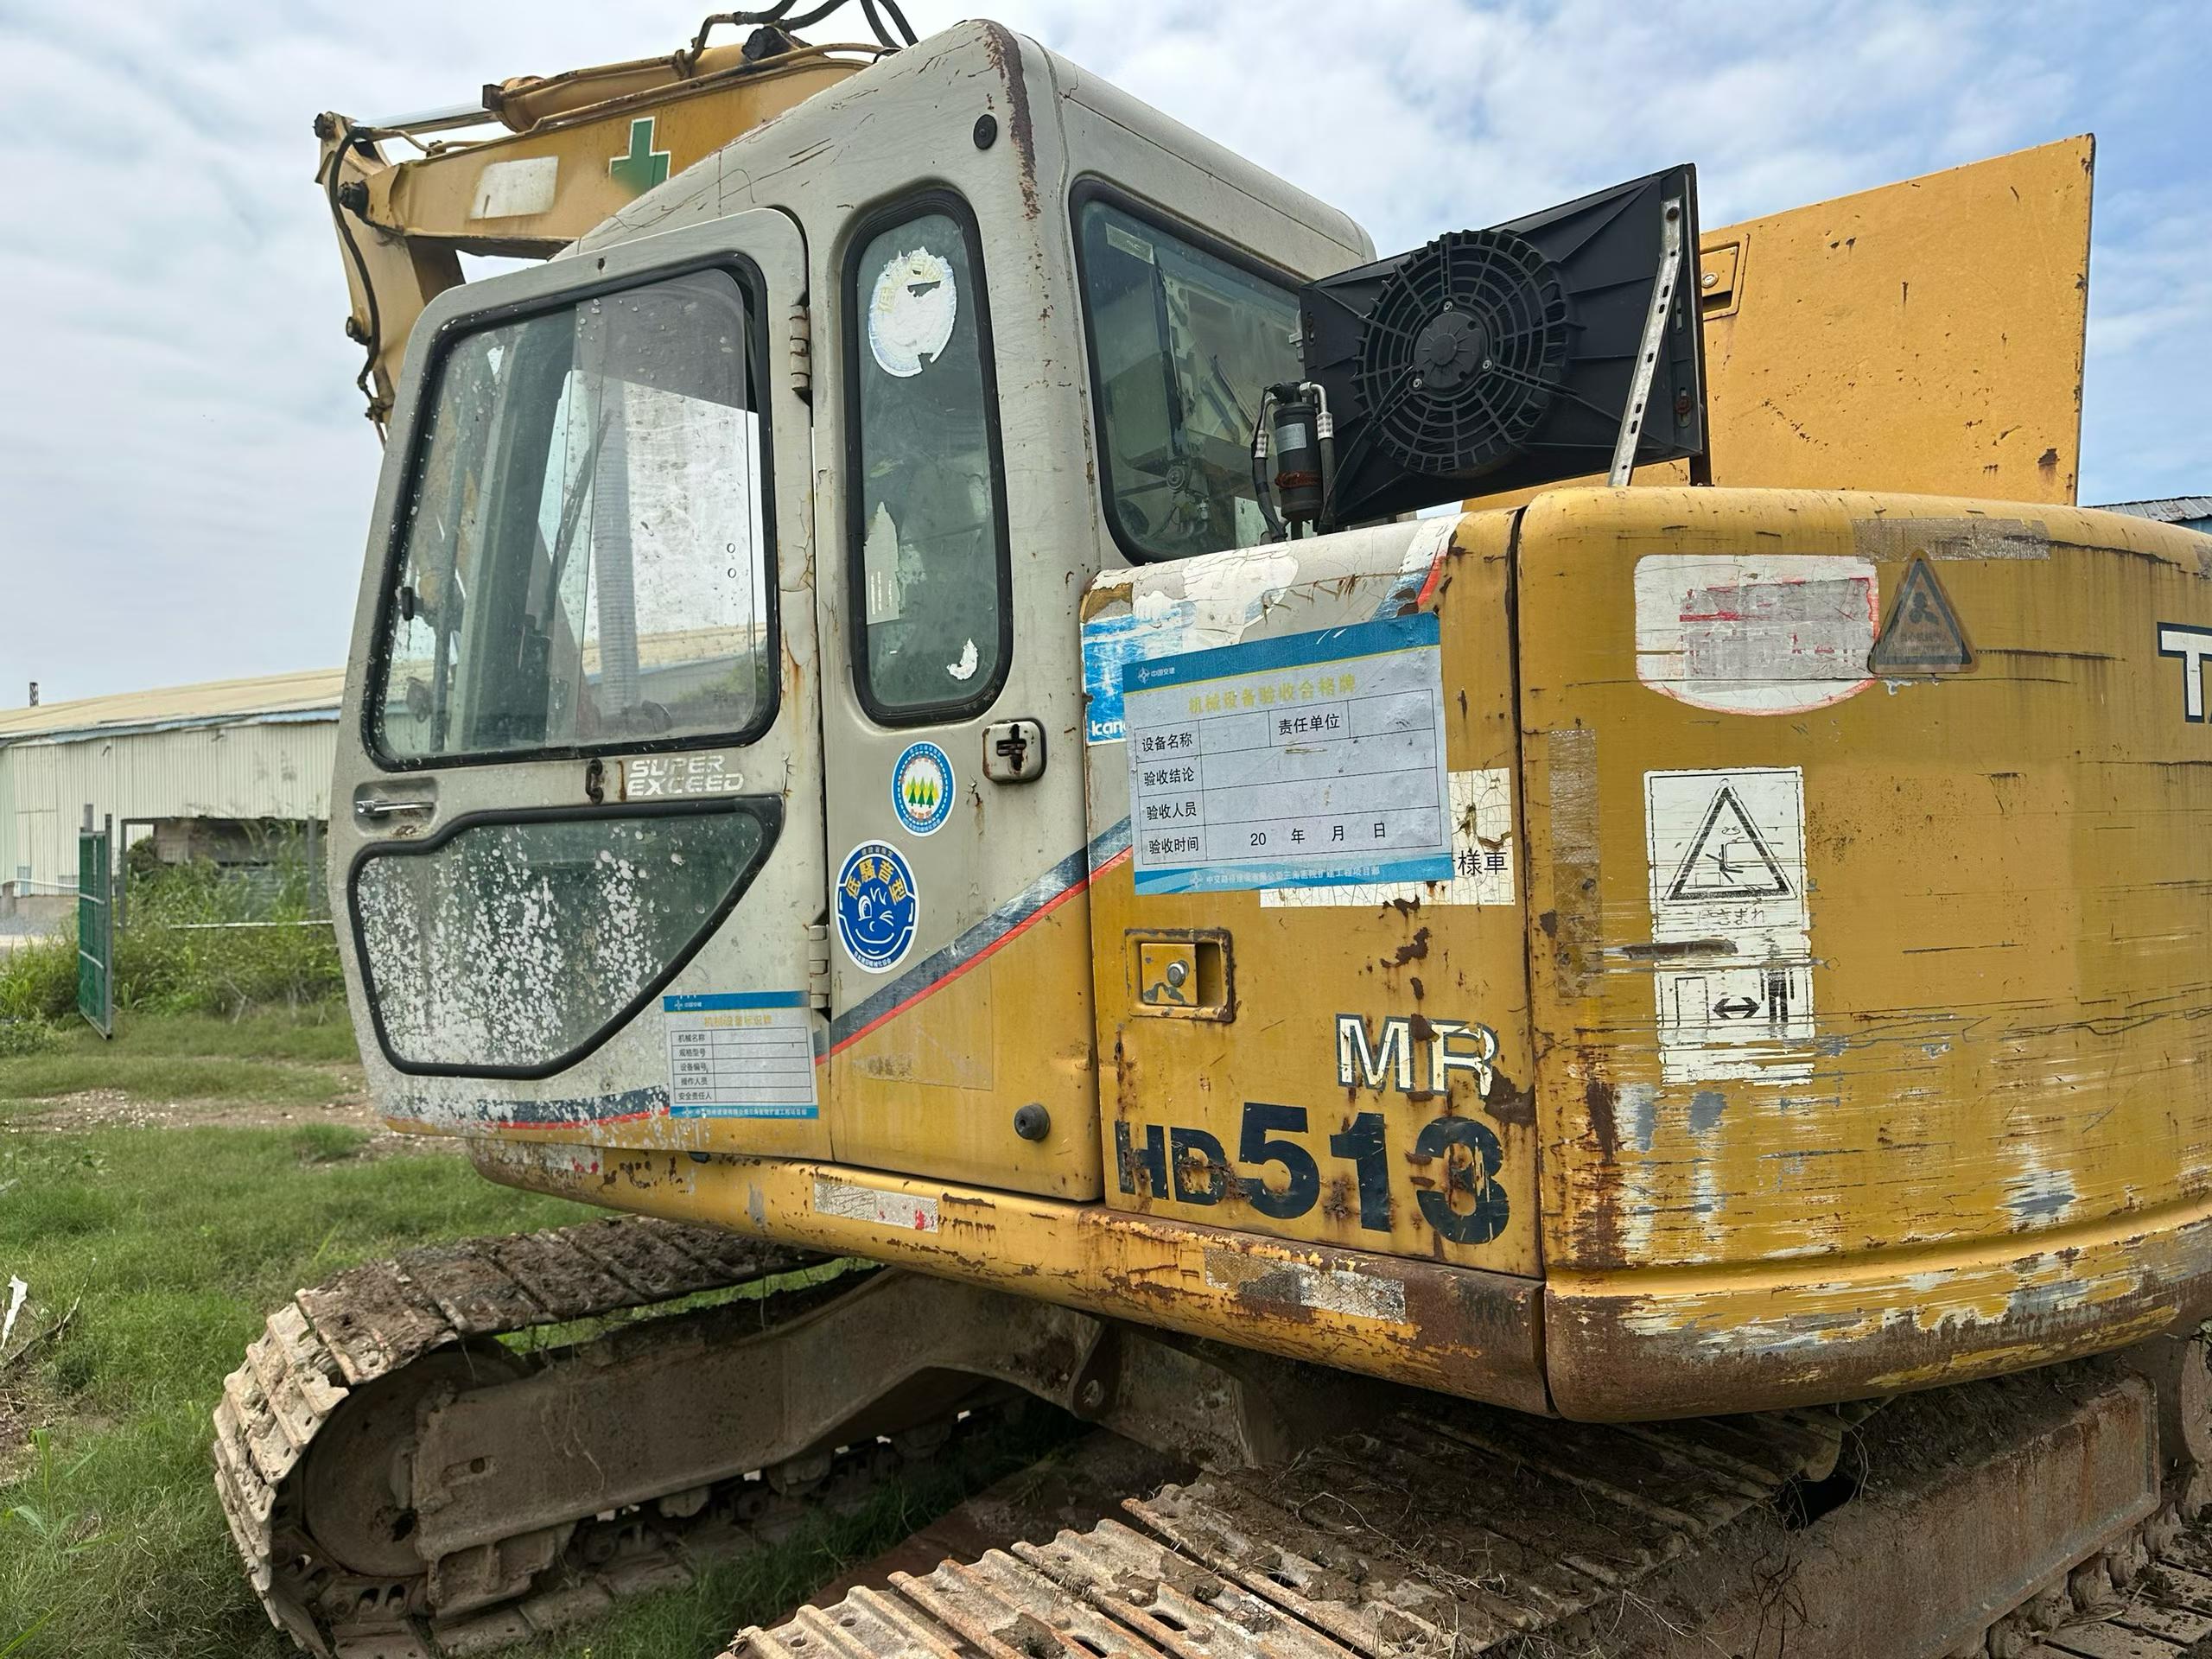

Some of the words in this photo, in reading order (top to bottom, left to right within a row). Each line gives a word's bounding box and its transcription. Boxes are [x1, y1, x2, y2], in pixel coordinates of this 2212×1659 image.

[2157, 621, 2212, 724] T
[1188, 673, 1356, 715] 机械设备验收合格牌
[1091, 719, 1127, 737] kan
[1278, 713, 1341, 735] 责任单位
[1141, 733, 1193, 753] 设备名称
[629, 755, 726, 778] SUPER
[626, 773, 745, 797] EXCEED
[1143, 767, 1195, 787] 验收结论
[1146, 801, 1198, 821] 验收人员
[1250, 832, 1267, 847] 20
[1291, 829, 1306, 844] 年
[1331, 825, 1345, 842] 月
[1374, 822, 1387, 839] 日
[1148, 836, 1199, 855] 验收时间
[1452, 849, 1508, 876] 様車
[845, 857, 907, 906] 低騒音型
[677, 1033, 706, 1043] 机械名称
[678, 1048, 706, 1058] 规格型号
[1335, 1013, 1499, 1098] MR
[680, 1063, 707, 1072] 设备编号
[681, 1077, 709, 1086] 操作人员
[678, 1091, 712, 1101] 安全责任人
